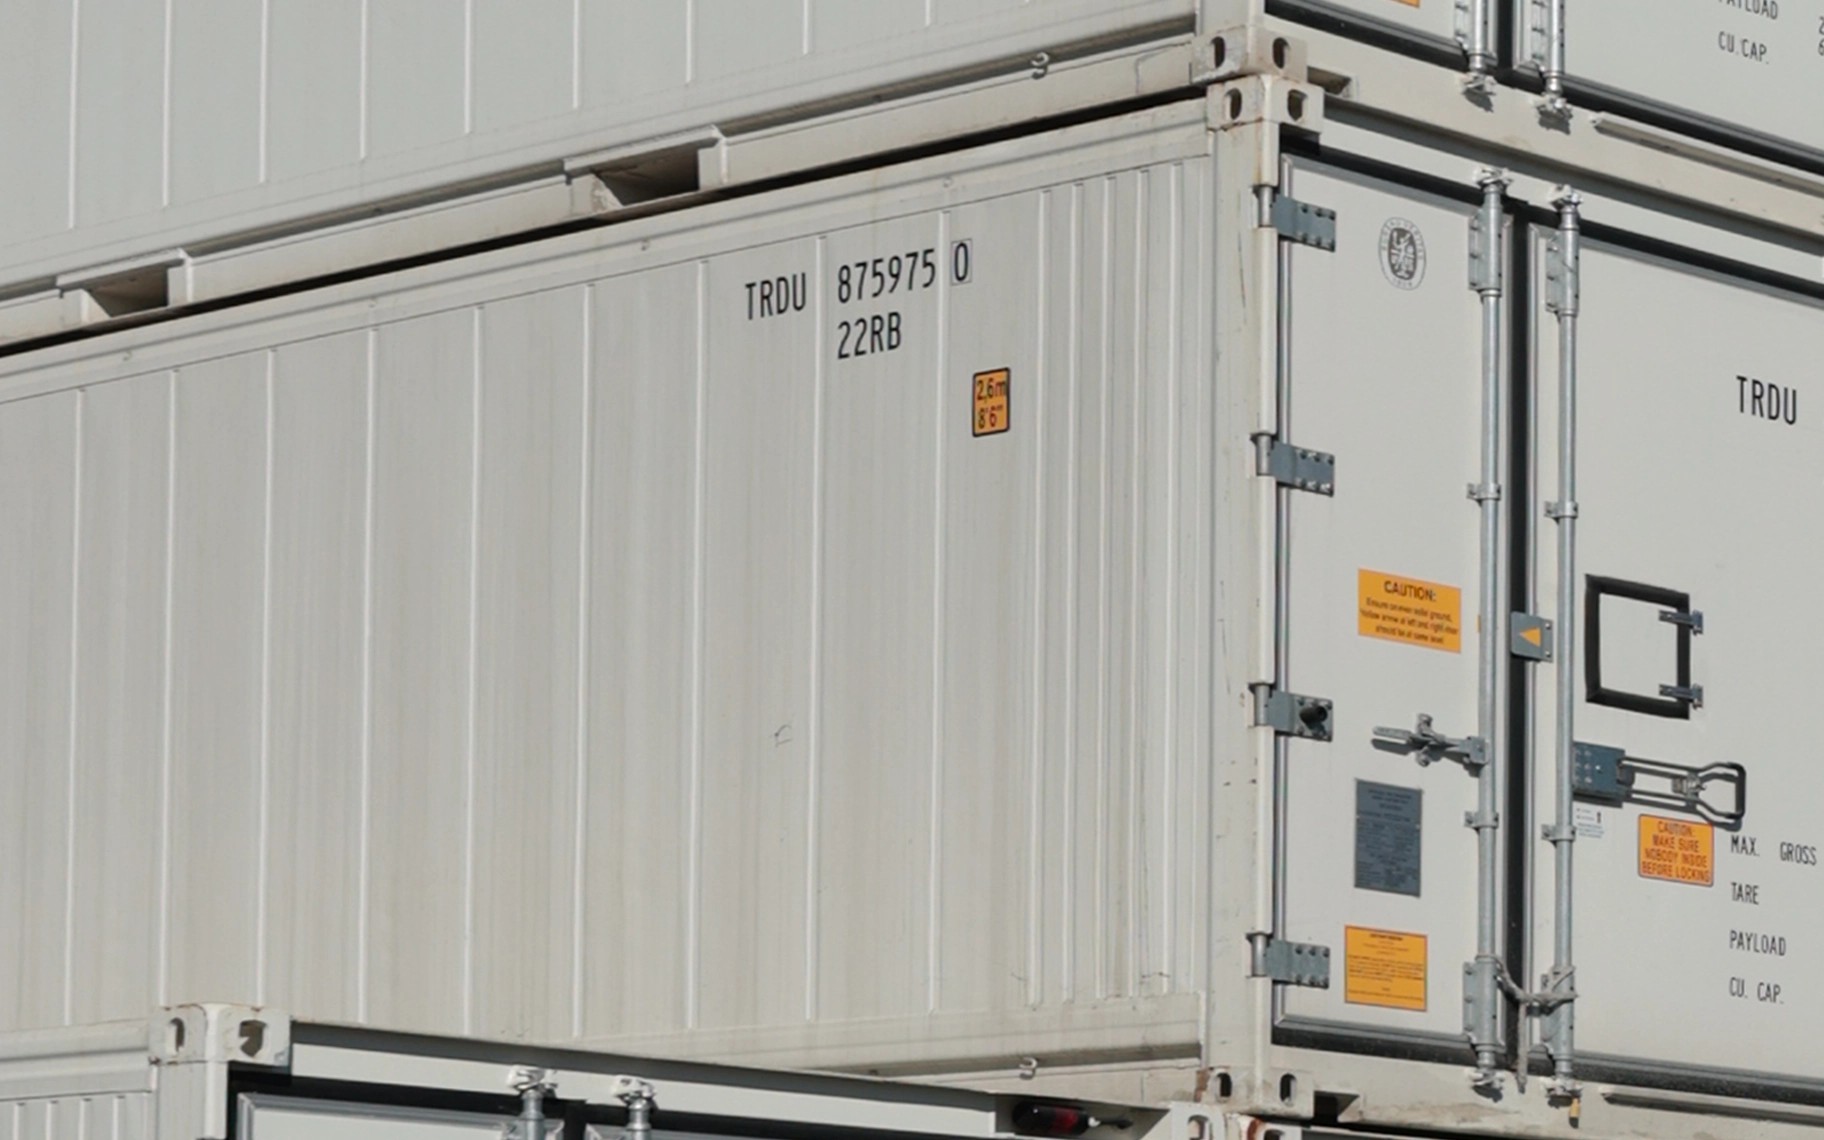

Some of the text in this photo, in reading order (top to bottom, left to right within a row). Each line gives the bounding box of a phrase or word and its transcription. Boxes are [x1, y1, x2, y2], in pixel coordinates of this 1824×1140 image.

[1719, 0, 1778, 20] LOAD
[745, 242, 970, 320] TRDU 875975 0
[837, 311, 902, 360] 22RB
[1736, 375, 1797, 425] TRDU
[1384, 580, 1437, 602] CAUTION:
[1730, 835, 1759, 857] MAX.
[1780, 841, 1817, 867] GROSS
[1731, 881, 1759, 905] TARE
[1729, 930, 1787, 958] PAYLOAD
[1729, 977, 1784, 1004] CU. CAP.
